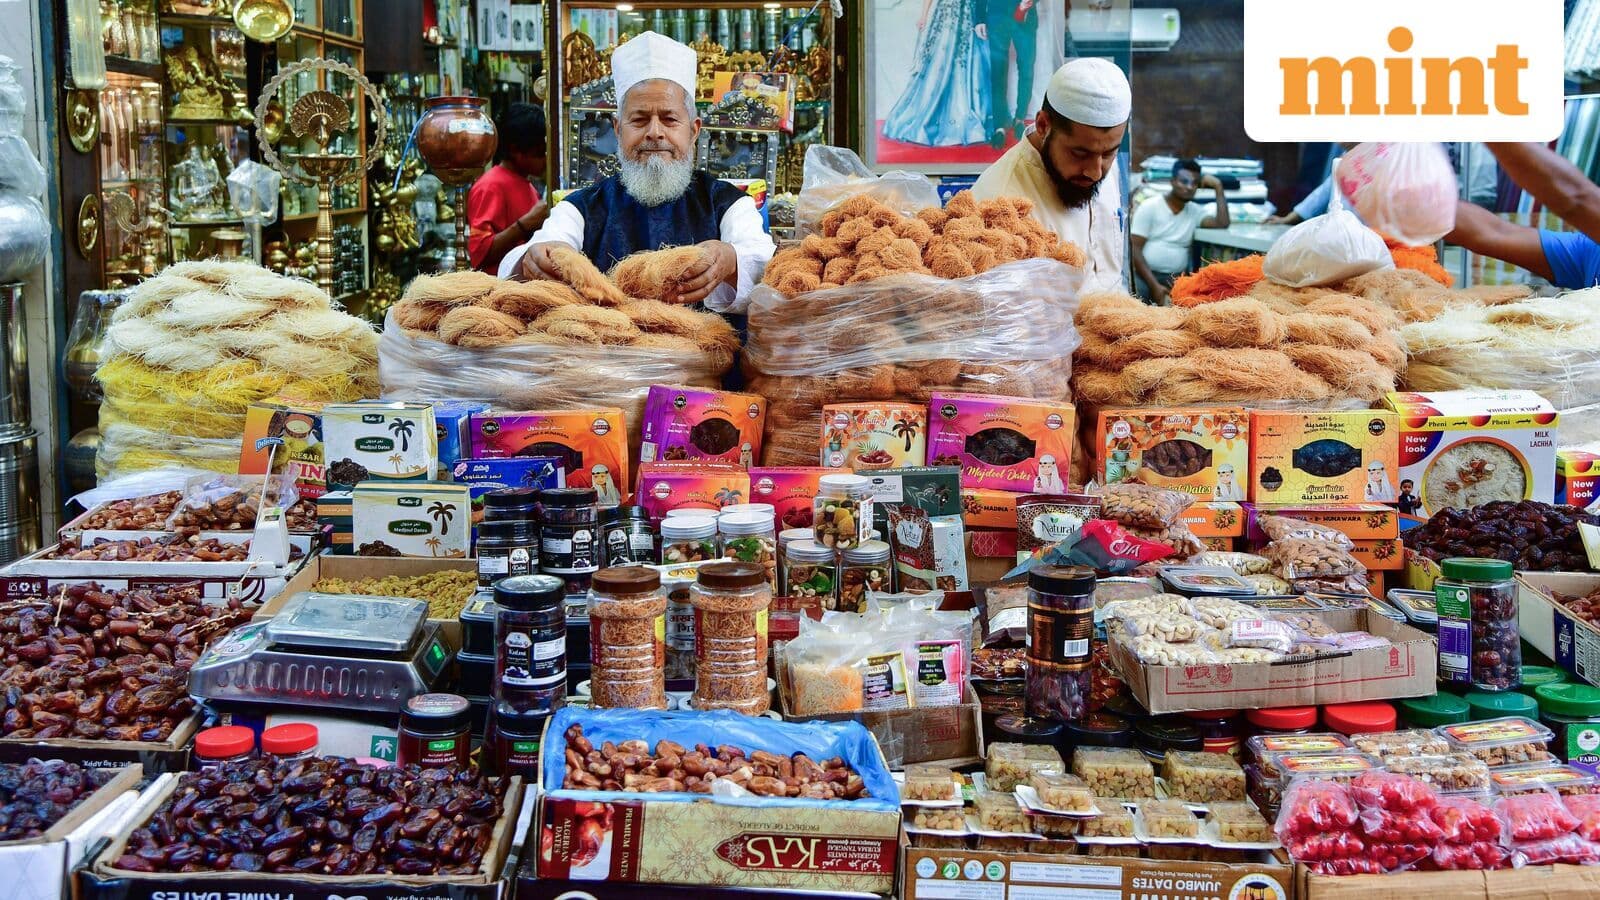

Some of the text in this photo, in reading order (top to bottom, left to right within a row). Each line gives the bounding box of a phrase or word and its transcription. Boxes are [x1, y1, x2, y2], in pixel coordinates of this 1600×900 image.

[1405, 445, 1426, 454] look
[291, 452, 320, 462] KESAR
[1007, 469, 1031, 481] Dates
[1572, 480, 1594, 489] New
[1572, 489, 1594, 499] look
[1039, 520, 1076, 537] Natural
[1580, 755, 1598, 764] FARD
[554, 825, 563, 856] DATES
[561, 818, 573, 862] ALGERIAN
[621, 807, 634, 878] PREMIUM DATES
[746, 836, 821, 869] KAS
[856, 845, 881, 853] KURMA
[849, 852, 881, 860] ALGERIAN
[1132, 878, 1222, 893] JUMBO DATES
